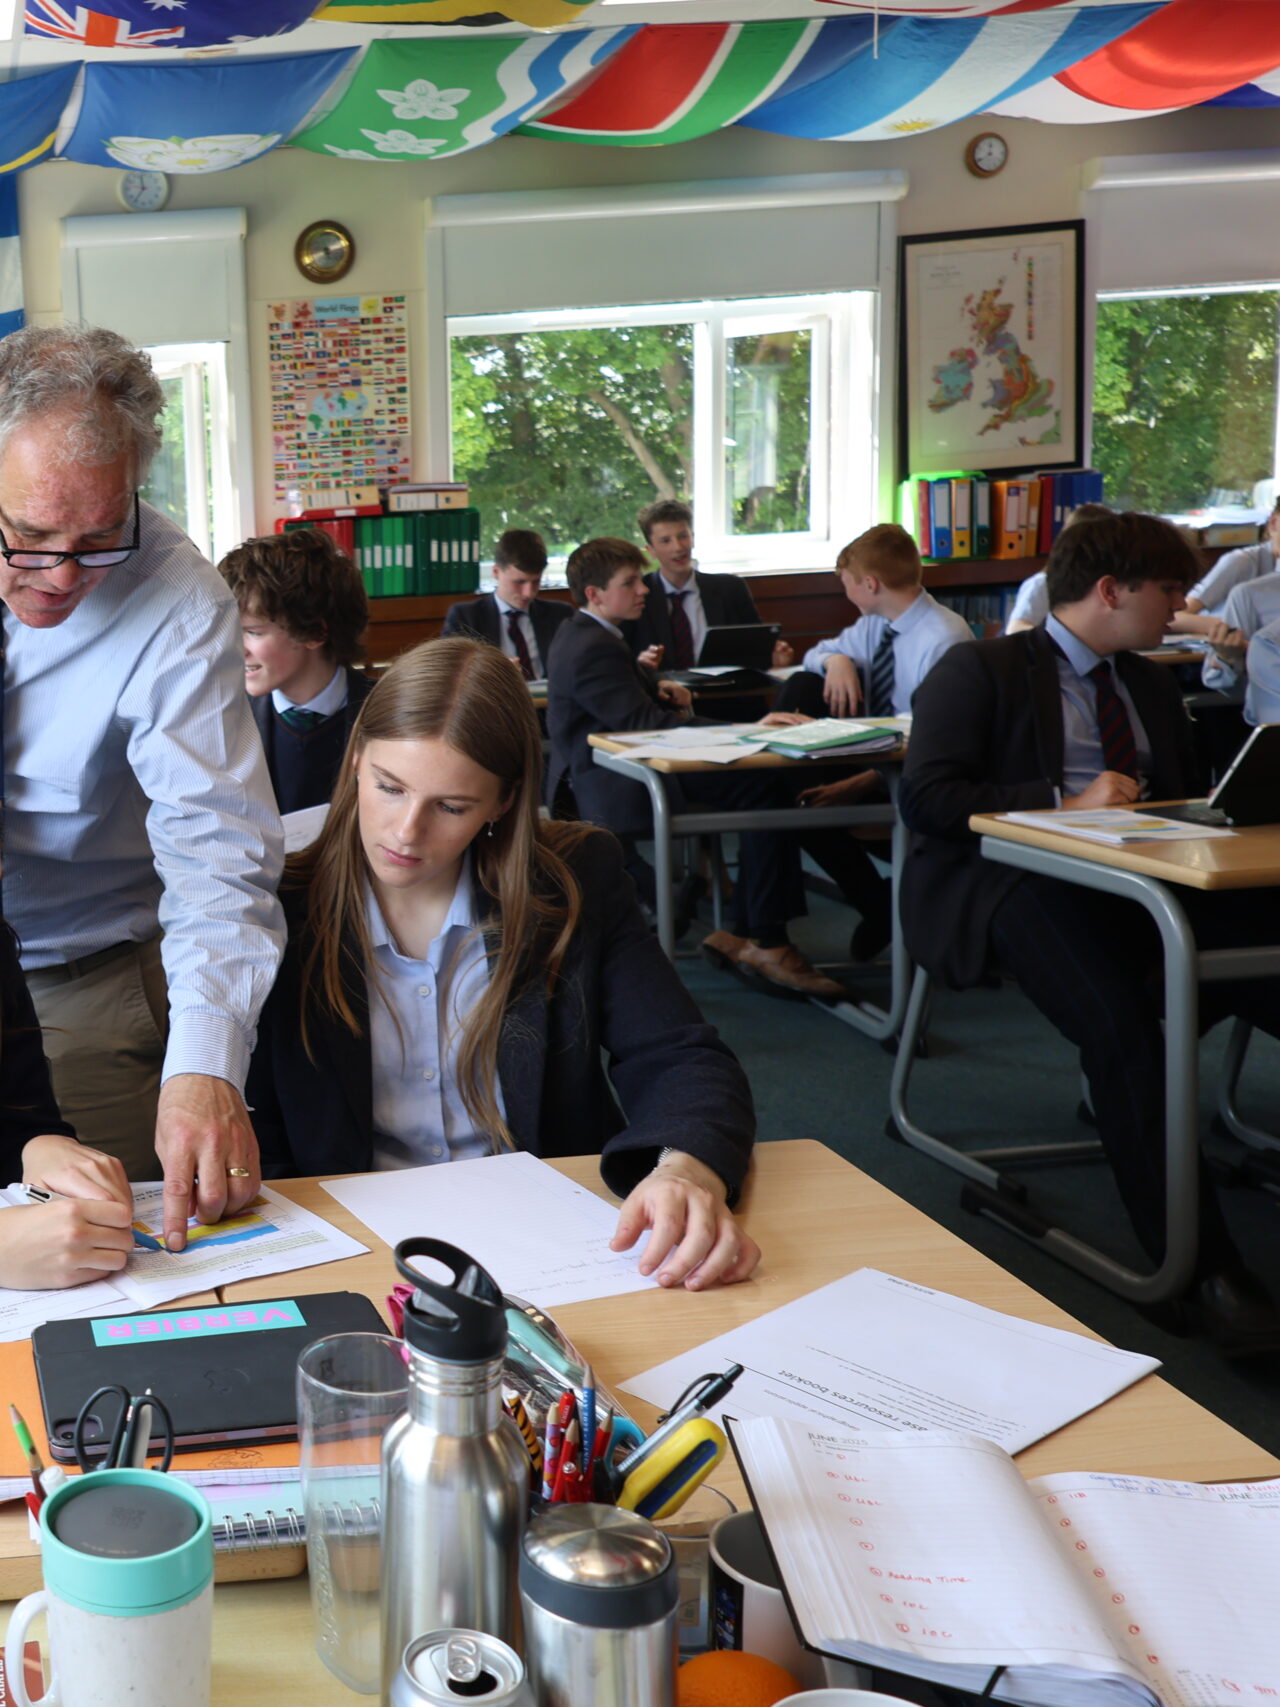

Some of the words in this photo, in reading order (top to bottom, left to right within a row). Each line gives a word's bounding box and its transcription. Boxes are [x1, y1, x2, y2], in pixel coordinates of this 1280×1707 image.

[315, 303, 338, 313] World
[339, 302, 359, 314] Flags
[106, 1308, 293, 1338] VERBIER
[777, 1369, 830, 1395] booklet
[832, 1390, 900, 1422] resources
[902, 1419, 928, 1431] ase
[808, 1432, 838, 1443] JUNE
[1219, 1491, 1253, 1503] JUNE
[1257, 1490, 1280, 1501] 202
[887, 1571, 933, 1584] Reading
[936, 1575, 972, 1584] Time
